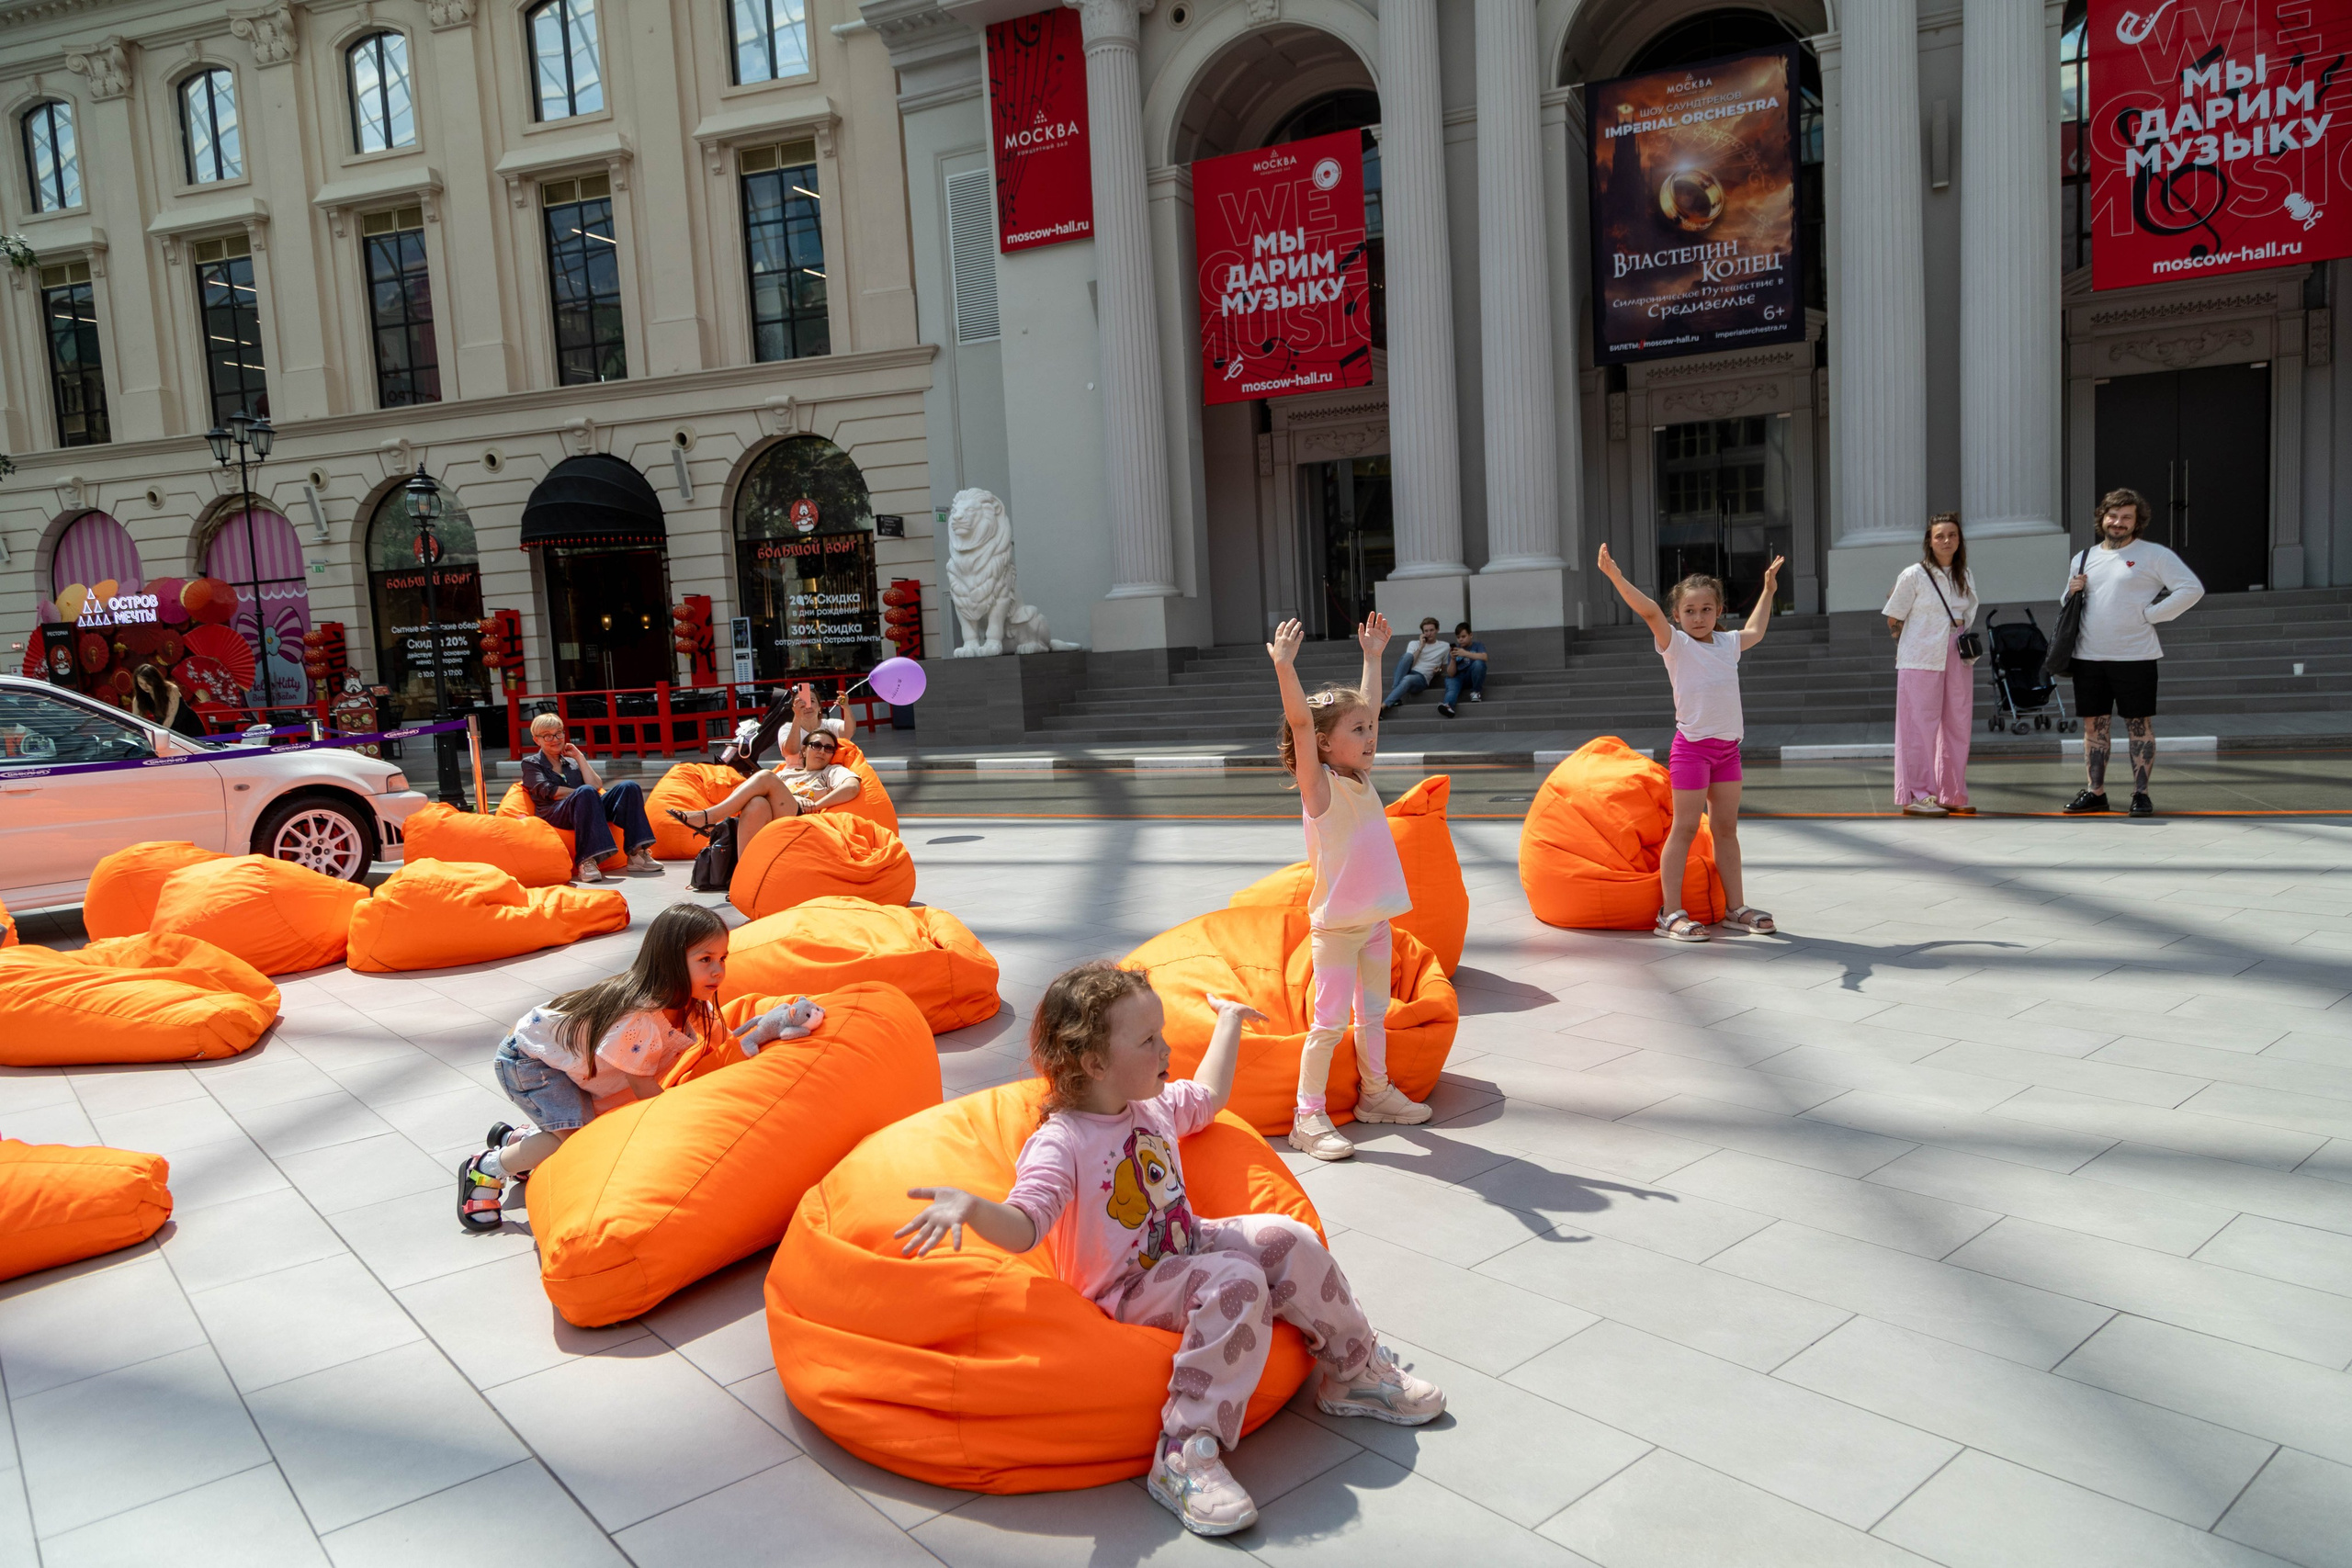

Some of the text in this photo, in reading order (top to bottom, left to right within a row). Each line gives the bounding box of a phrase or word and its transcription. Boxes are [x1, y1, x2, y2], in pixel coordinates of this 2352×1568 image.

[2183, 54, 2266, 97] МЫ
[1667, 77, 1713, 95] МОСКВА
[1640, 107, 1664, 118] ШОУ
[1666, 92, 1742, 113] САУНДТРЕКОВ
[2136, 81, 2314, 147] ДАРИМ
[1605, 96, 1779, 139] IMPERIAL ORCHESTRA
[1005, 120, 1080, 150] МОСКВА
[2125, 113, 2334, 177] МУЗЫКУ
[1253, 155, 1297, 173] МОСКВА
[1007, 220, 1090, 244] moscow-hall.ru
[1254, 227, 1305, 258] МЫ
[2153, 241, 2301, 274] moscow-hall.ru
[1227, 250, 1336, 294] ДАРИМ
[1221, 276, 1346, 318] МУЗЫКУ
[1763, 305, 1785, 321] 6+
[1715, 323, 1788, 339] imperialorchestra.ru
[1241, 372, 1333, 393] moscow-hall.ru
[757, 537, 858, 559] БОЛЬШОЙ ВОНГ
[386, 570, 471, 589] БОЛЬШЙ ВОНГ
[108, 594, 158, 611] ОСТРОВ
[789, 593, 861, 606] 20% Скидка
[114, 608, 157, 624] МЕЧТЫ
[798, 609, 815, 617] дни
[816, 607, 860, 617] рождения
[391, 626, 419, 634] Сытные
[791, 623, 863, 636] 30% Скидка
[446, 636, 469, 647] 20%
[775, 638, 822, 647] сотрудникам
[822, 637, 855, 645] Острова
